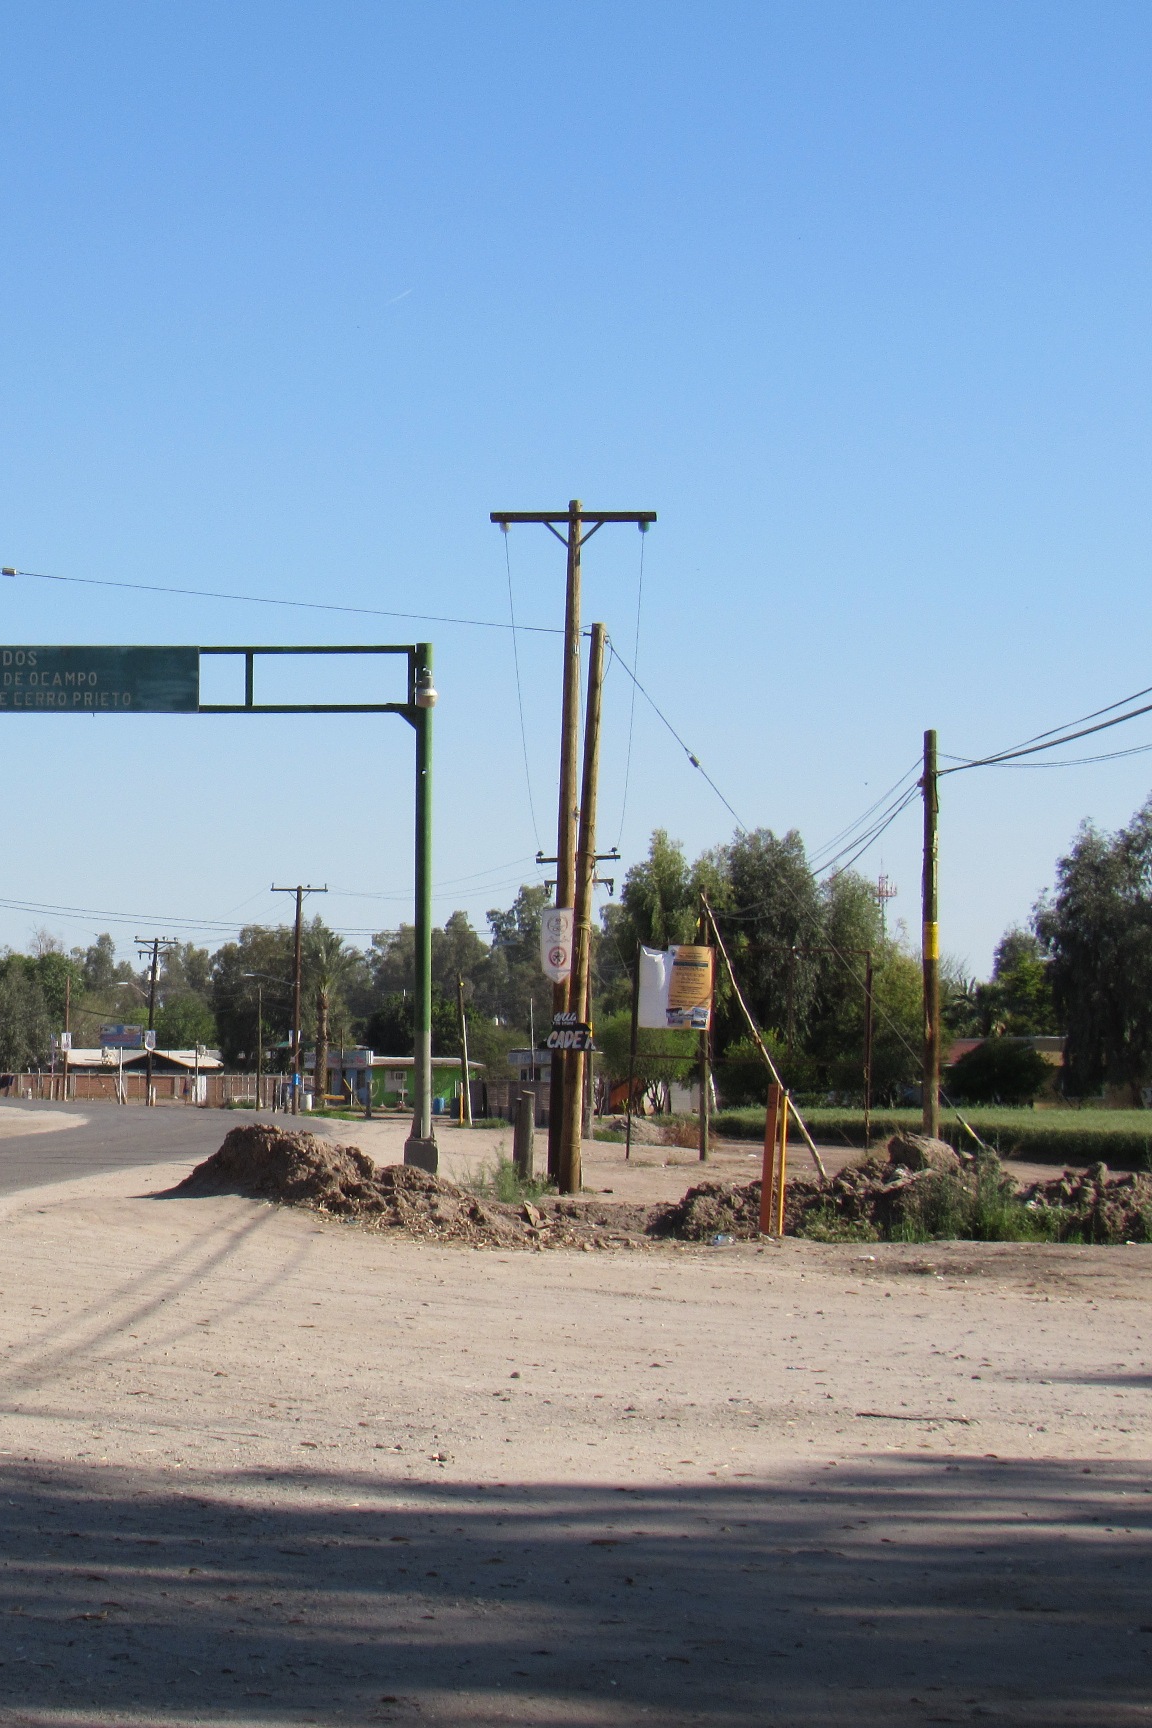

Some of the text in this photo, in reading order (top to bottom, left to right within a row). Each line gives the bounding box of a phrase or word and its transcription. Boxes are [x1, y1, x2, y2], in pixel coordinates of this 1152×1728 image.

[3, 671, 24, 686] DE
[29, 671, 98, 686] OCAMPO
[13, 692, 67, 706] CERRO
[72, 692, 132, 706] PRIETO
